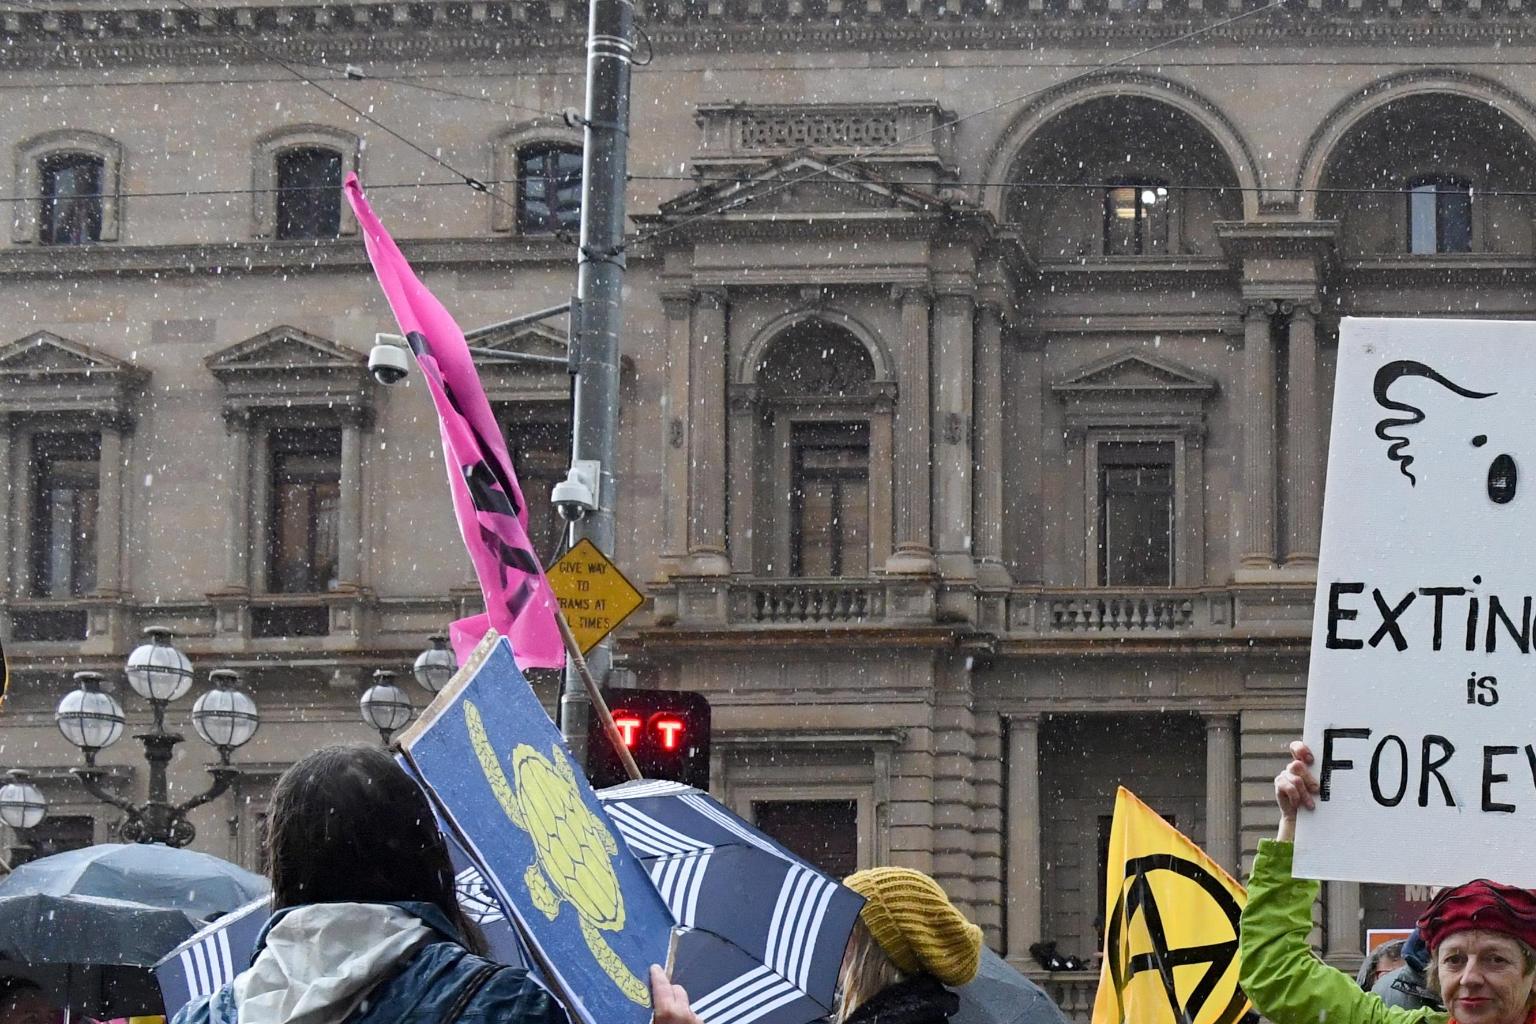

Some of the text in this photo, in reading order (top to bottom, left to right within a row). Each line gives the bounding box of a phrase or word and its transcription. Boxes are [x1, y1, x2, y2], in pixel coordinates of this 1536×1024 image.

[560, 561, 608, 575] GIVE WAY
[576, 581, 590, 592] TO
[595, 600, 606, 611] AT
[580, 616, 610, 630] TIMES
[1467, 671, 1500, 706] is
